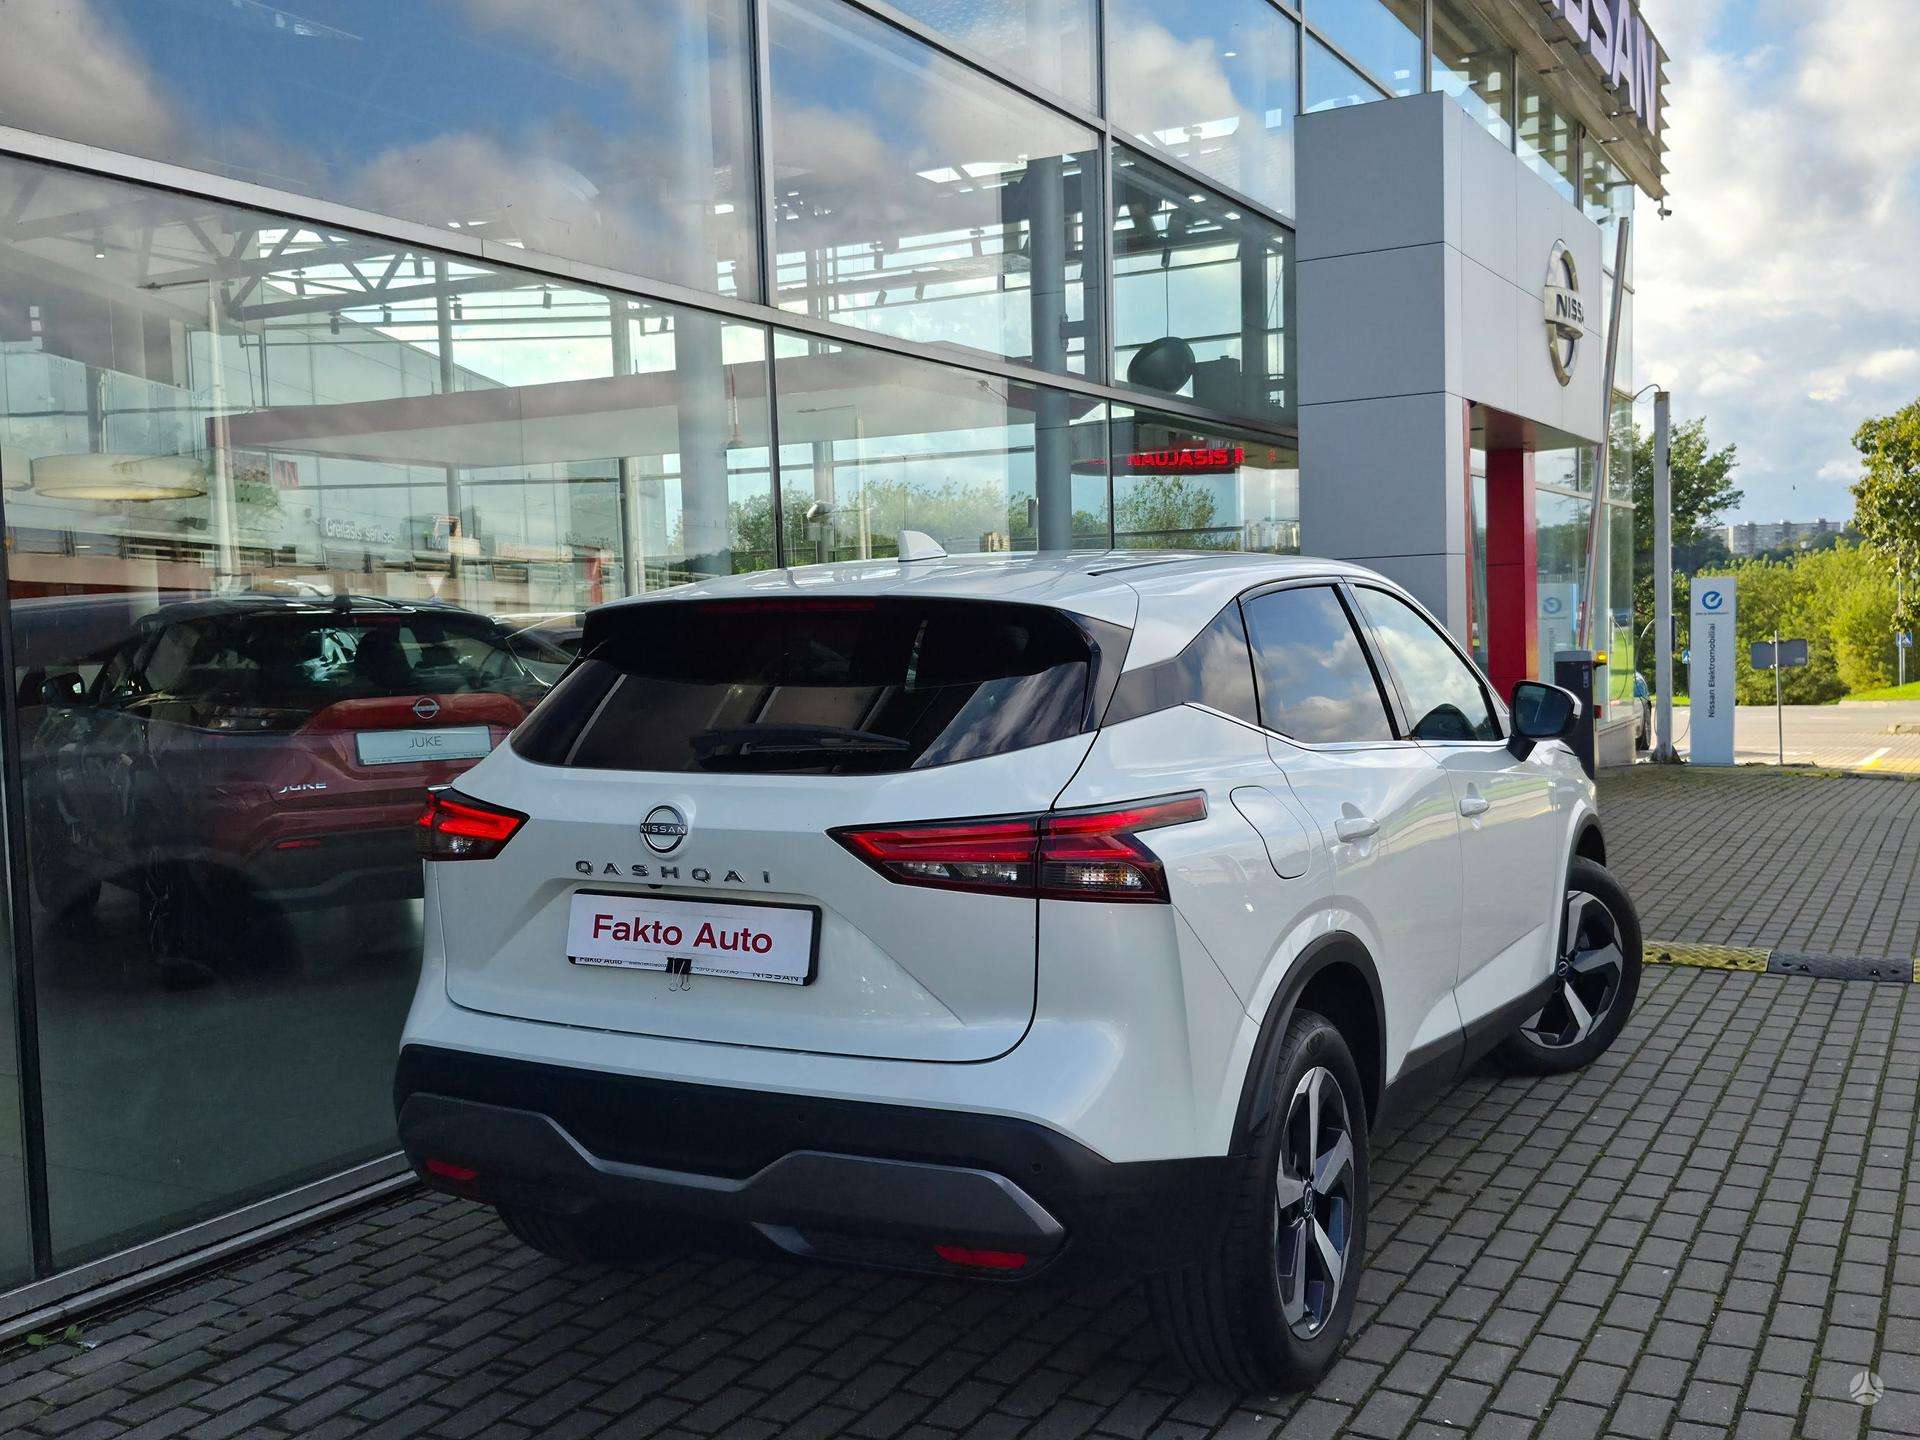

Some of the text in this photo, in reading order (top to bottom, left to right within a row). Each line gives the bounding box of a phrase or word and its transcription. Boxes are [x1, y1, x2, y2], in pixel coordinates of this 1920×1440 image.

[1556, 294, 1584, 324] NISS
[1127, 449, 1229, 466] NAUJASIS
[1708, 623, 1716, 718] Nissan Elektromobiliai
[409, 735, 442, 749] JUKE
[641, 824, 687, 834] NISSAN
[575, 860, 771, 884] QASHQAI
[592, 913, 773, 954] Fakto Auto
